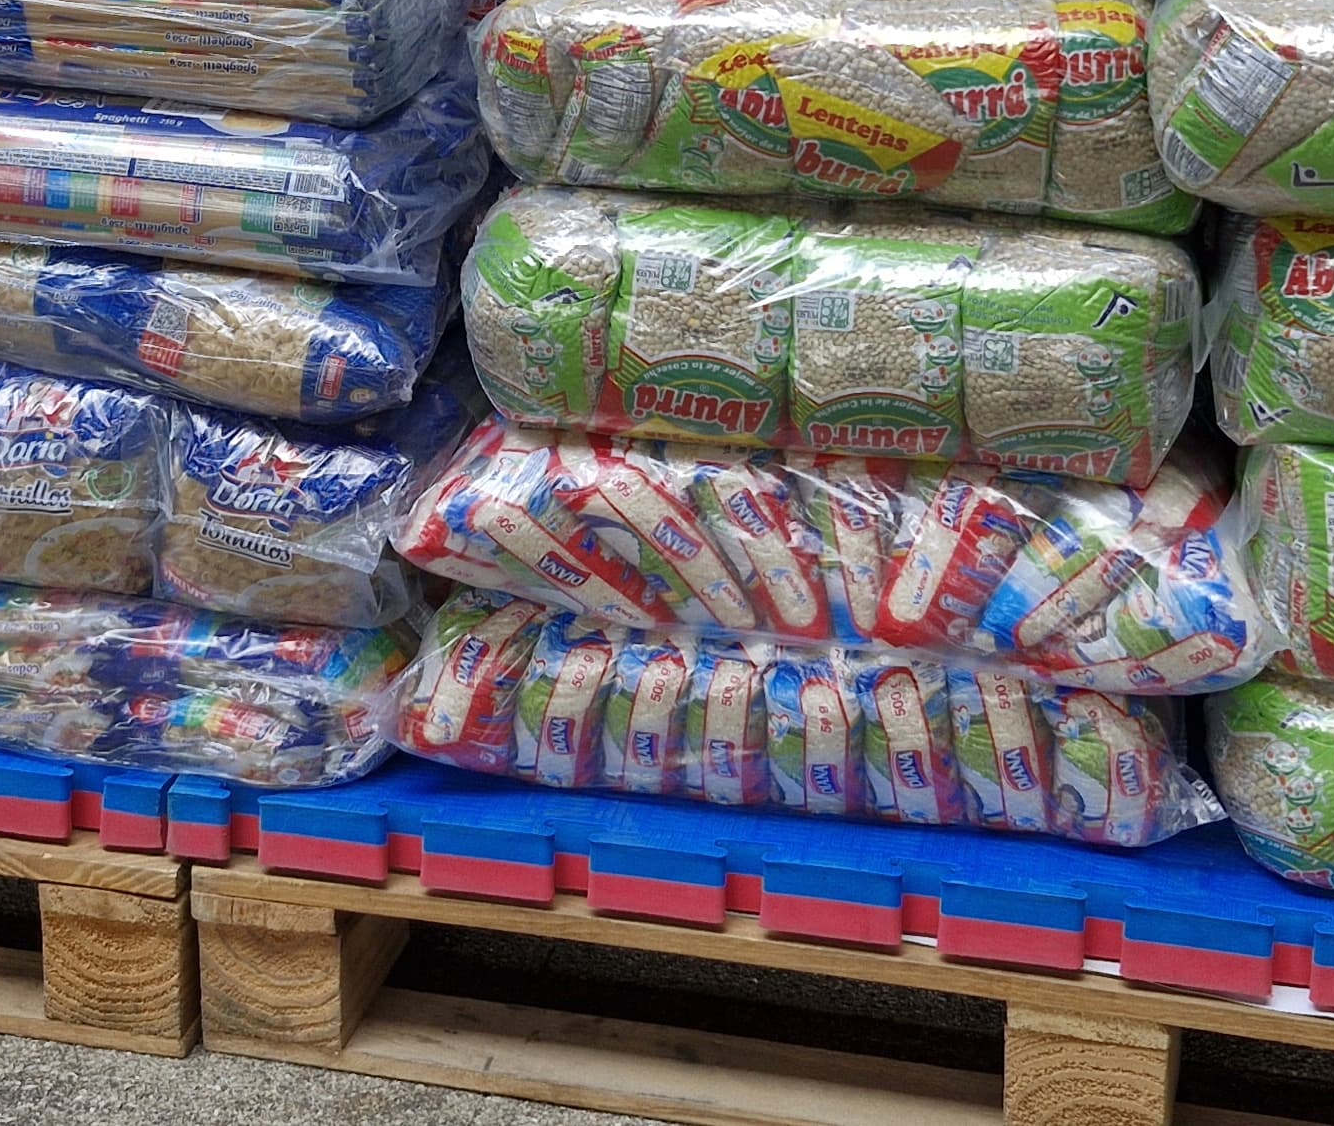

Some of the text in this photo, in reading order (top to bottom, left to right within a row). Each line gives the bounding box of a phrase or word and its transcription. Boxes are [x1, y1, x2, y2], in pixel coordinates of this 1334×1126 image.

[203, 62, 258, 75] Spaghetti
[93, 112, 149, 124] Spaghetti
[797, 96, 910, 153] Lentejas
[135, 223, 190, 235] Spaghetti
[644, 361, 688, 383] Cosecha
[724, 365, 756, 387] mejor
[633, 383, 773, 435] Aburrá
[815, 399, 859, 419] Cosecha
[893, 398, 932, 420] mejor
[808, 423, 950, 454] Aburrá
[212, 479, 296, 517] Doria
[727, 492, 767, 536] DIANA
[200, 510, 293, 563] Tornillos
[654, 521, 699, 559] DIANA
[539, 554, 589, 586] DIANA
[456, 637, 484, 685] DIANA
[1189, 648, 1213, 664] 500
[571, 666, 586, 689] 500
[650, 677, 666, 703] 500
[893, 690, 907, 718] 500
[999, 682, 1011, 710] 500
[551, 717, 569, 754] DIANA
[897, 752, 921, 788] DIANA
[1004, 748, 1027, 790] DIANA
[1118, 752, 1140, 795] DIANA
